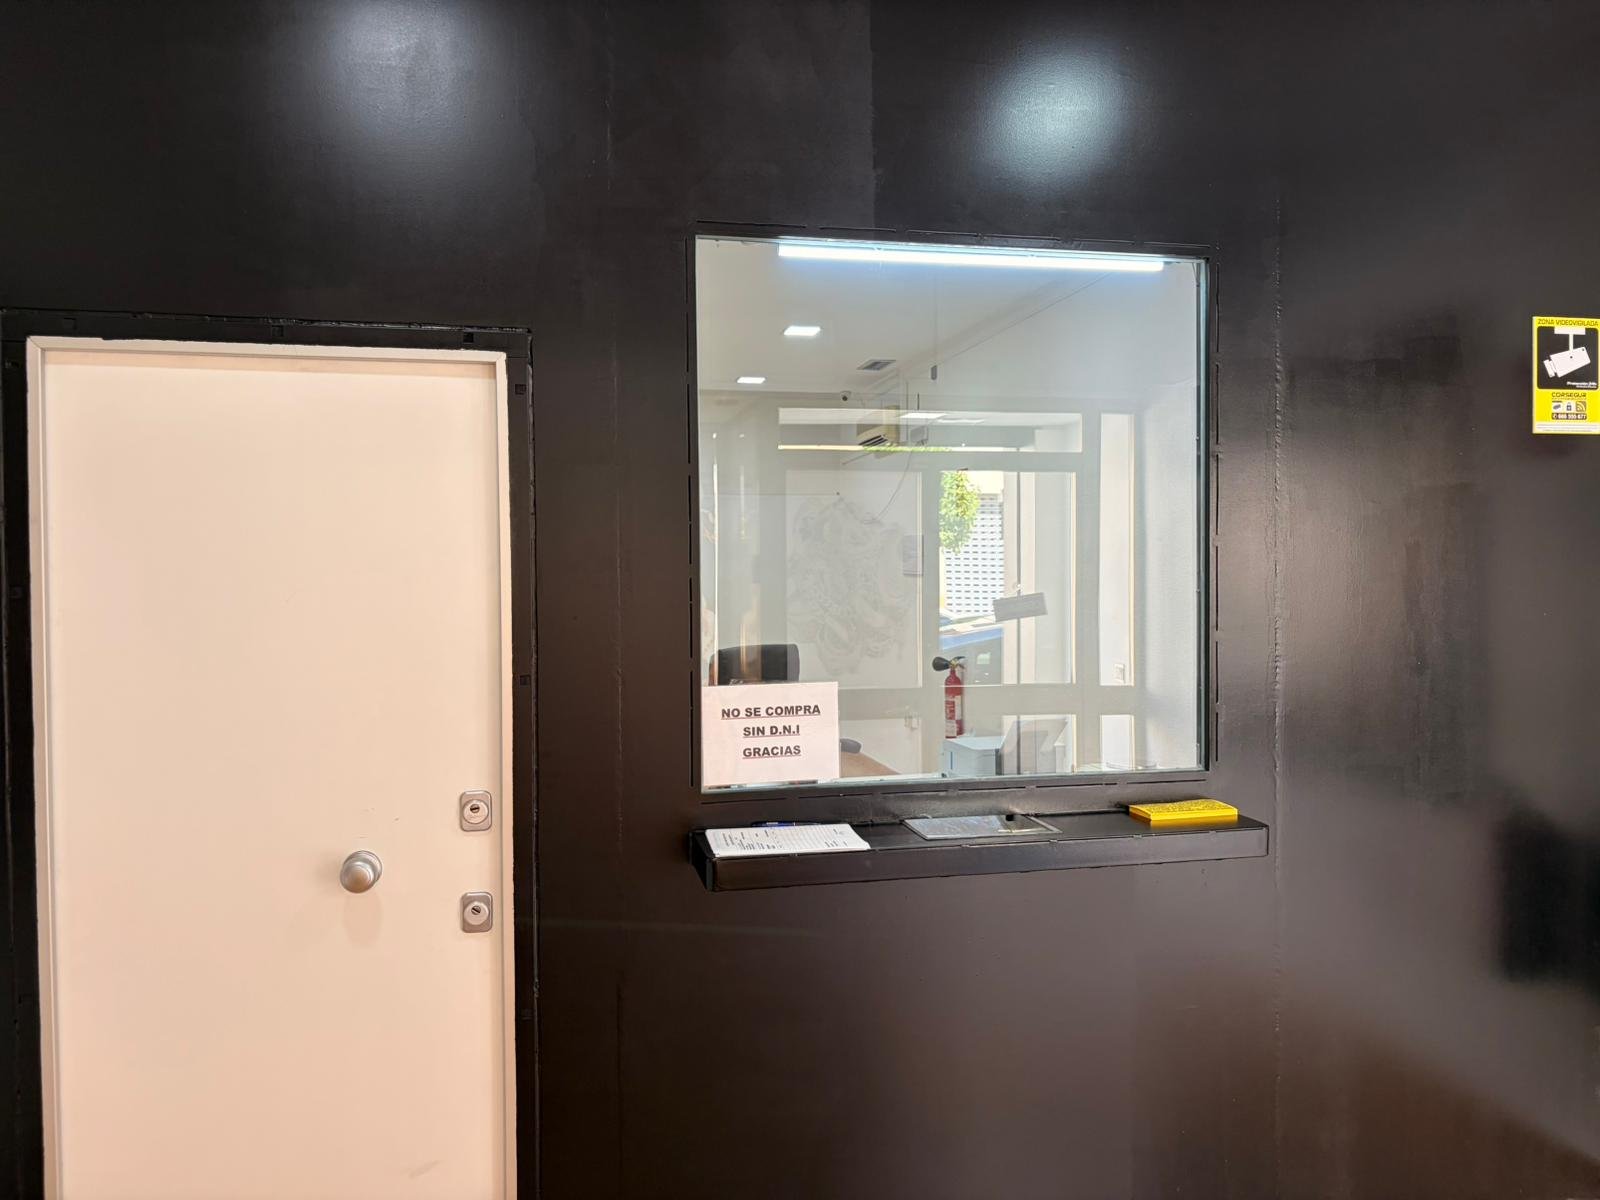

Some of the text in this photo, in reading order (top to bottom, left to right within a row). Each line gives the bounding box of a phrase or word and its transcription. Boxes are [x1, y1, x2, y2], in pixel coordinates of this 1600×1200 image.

[721, 705, 821, 719] NO SE COMPRA
[743, 724, 800, 737] SIN D.N.I
[742, 745, 801, 758] GRACIAS
